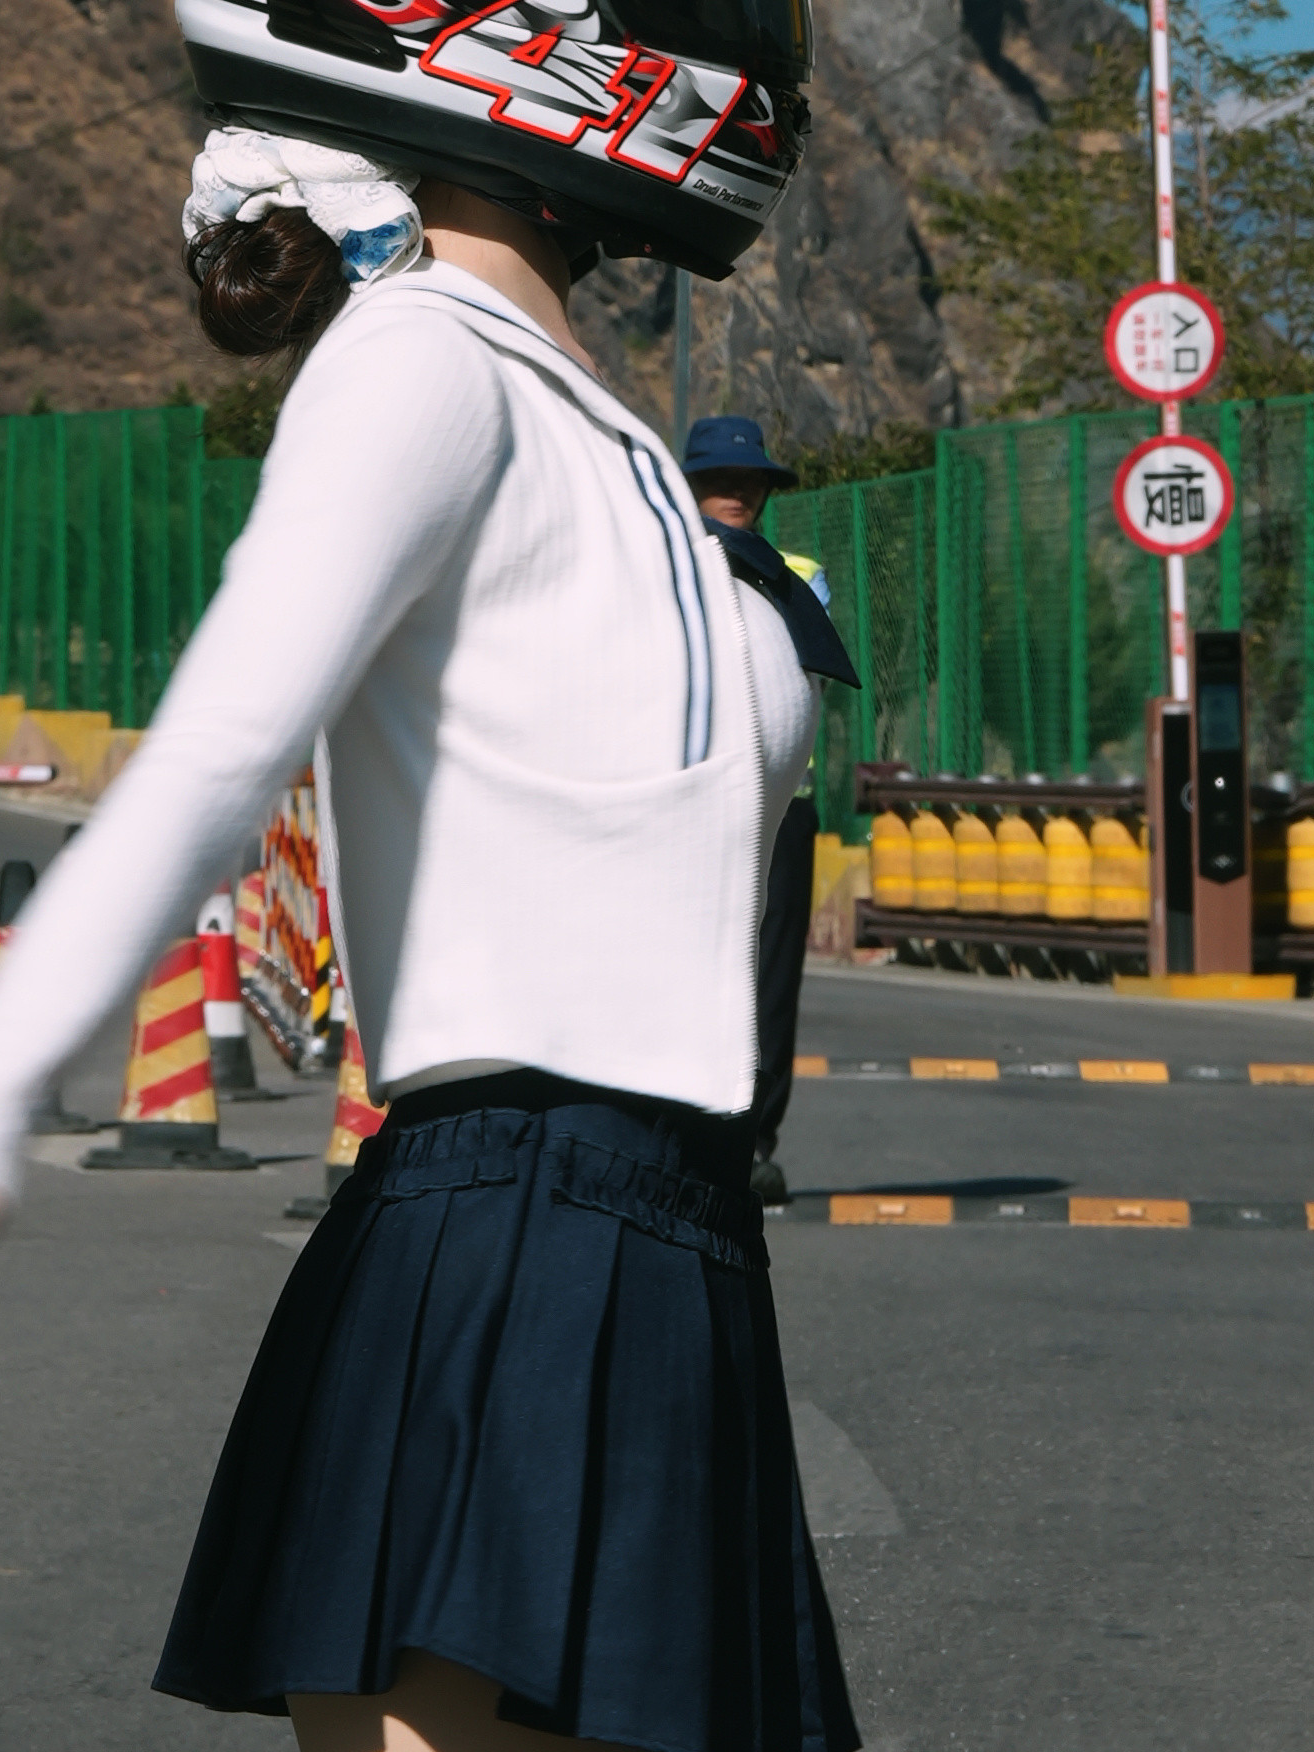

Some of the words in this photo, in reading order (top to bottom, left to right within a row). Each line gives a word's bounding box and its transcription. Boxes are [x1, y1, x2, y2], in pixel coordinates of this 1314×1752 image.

[692, 178, 719, 197] Drudi
[1172, 311, 1200, 374] 入口
[1142, 463, 1206, 528] 慢
